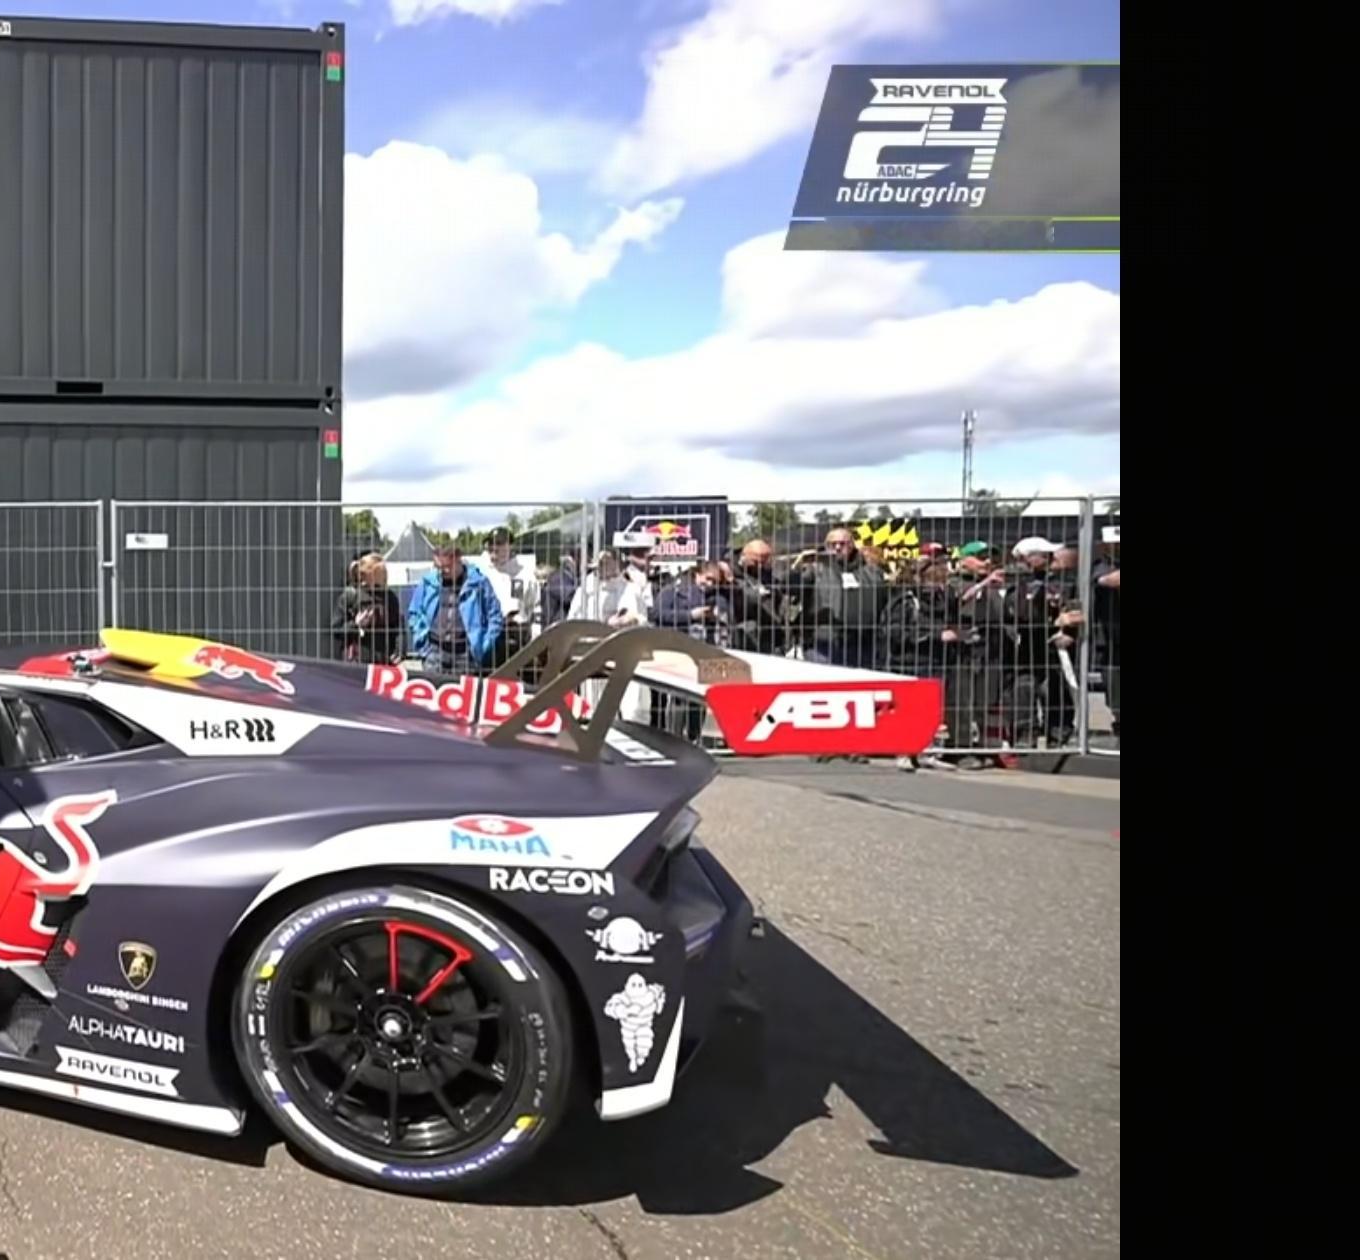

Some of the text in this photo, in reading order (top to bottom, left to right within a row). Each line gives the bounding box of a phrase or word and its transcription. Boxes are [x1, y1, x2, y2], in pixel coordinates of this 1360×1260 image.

[366, 664, 479, 727] Red
[189, 719, 241, 740] H&R
[745, 689, 893, 742] ABT
[450, 830, 552, 858] MAHA
[67, 1014, 185, 1054] ALPHATAURI
[66, 1055, 167, 1088] RAVENOL
